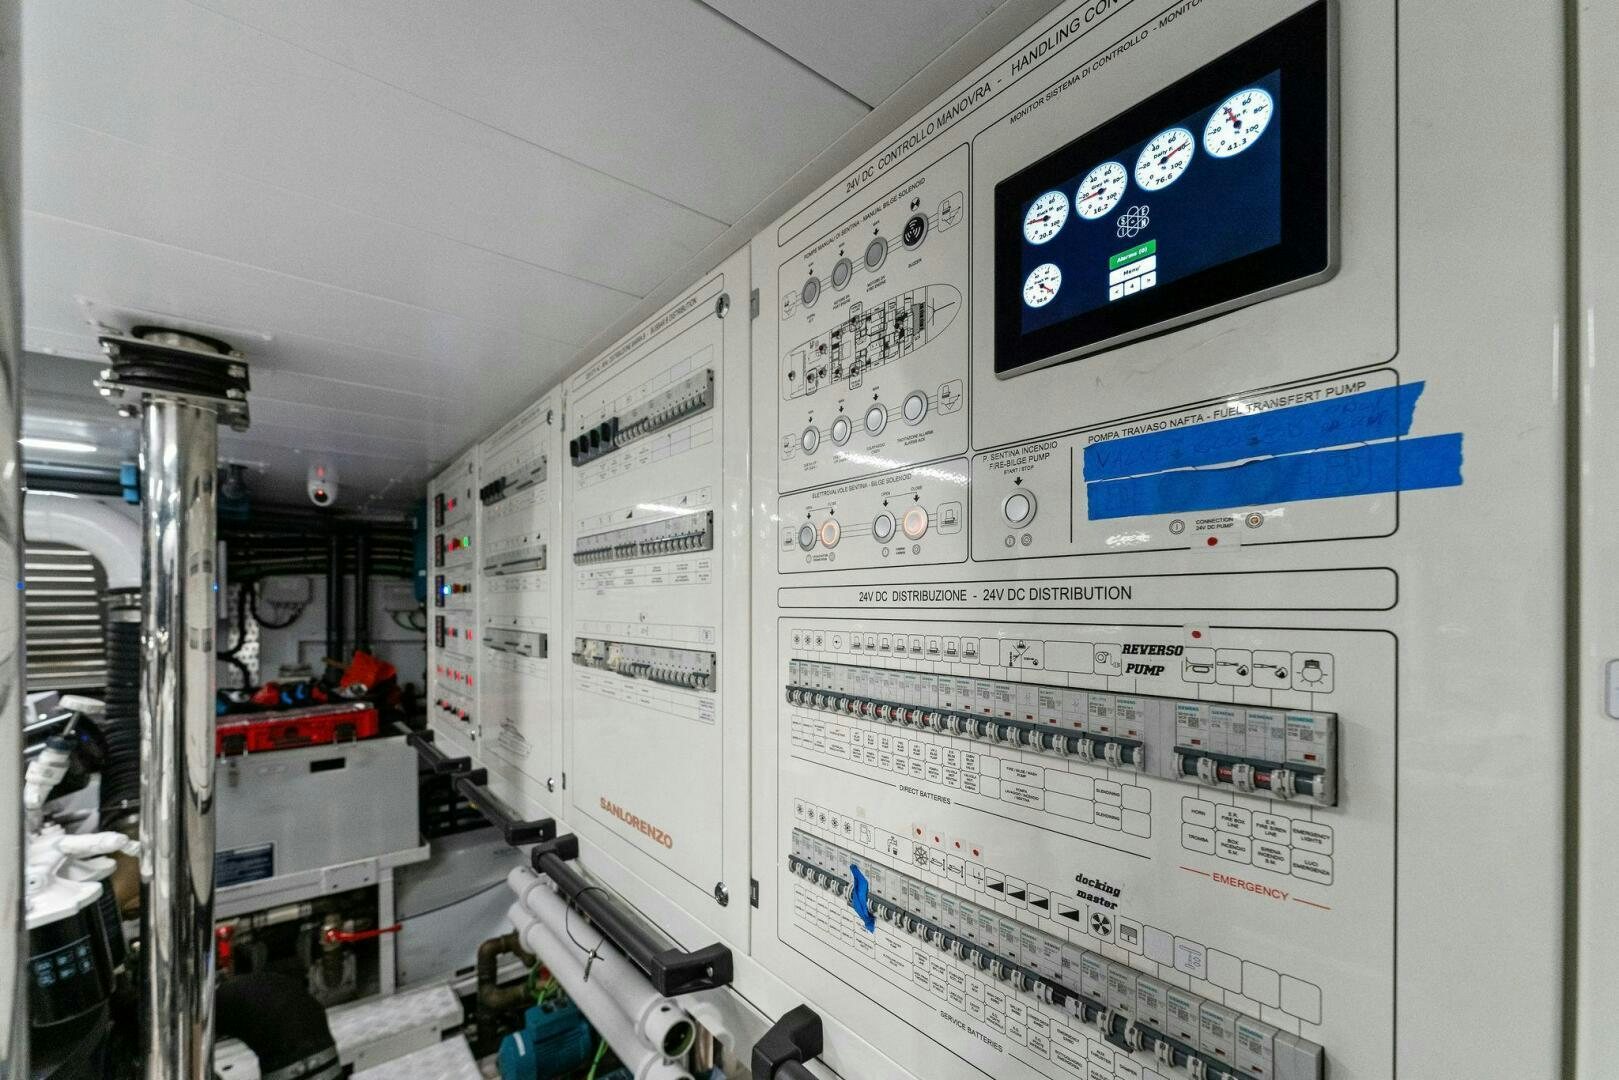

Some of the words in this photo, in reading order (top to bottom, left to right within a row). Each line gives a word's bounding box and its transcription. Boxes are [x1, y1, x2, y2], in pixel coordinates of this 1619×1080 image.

[1010, 97, 1045, 124] MONITOR
[1046, 74, 1080, 102] SISTEMA
[1082, 68, 1091, 80] DI
[1092, 30, 1149, 71] CONTROLLO
[1159, 0, 1202, 29] MONITO
[846, 176, 860, 194] 24V
[862, 166, 874, 182] DC
[878, 122, 934, 174] CONTROLLO
[936, 82, 992, 129] MANOVRA
[1010, 18, 1081, 76] HANDLING
[1246, 124, 1259, 134] 100
[1227, 138, 1247, 151] 41.3
[1153, 150, 1168, 160] Daily
[1170, 160, 1182, 170] 100
[1155, 173, 1173, 185] 76.6
[882, 196, 898, 210] BILGE
[898, 177, 926, 199] SOLENOID
[1106, 192, 1118, 200] 100
[1093, 204, 1108, 214] 16.2
[1088, 430, 1120, 444] POMPA
[1121, 420, 1168, 437] TRAVASO
[1169, 413, 1204, 428] NAFTA
[1213, 406, 1243, 420] FUEL
[1246, 389, 1321, 414] TRANSFERT
[1325, 380, 1366, 398] PUMP
[990, 450, 1020, 461] SENTINA
[1022, 440, 1058, 454] INCENDIO
[989, 458, 1027, 470] FIRE-BILGE
[1028, 452, 1050, 464] PUMP
[886, 473, 912, 485] SOLENOID
[859, 590, 874, 602] 24V
[875, 590, 888, 602] DC
[892, 589, 967, 602] DISTRIBUZIONE
[983, 588, 1004, 602] 24V
[1008, 588, 1026, 601] DC
[1030, 586, 1132, 600] DISTRIBUTION
[1122, 644, 1184, 656] REVERSO
[1126, 663, 1165, 676] PUMP
[899, 784, 920, 796] DIRECT
[920, 790, 951, 804] BATTERIES
[600, 797, 673, 849] SANLORENZO
[1292, 828, 1331, 840] EMERGENCY
[1075, 873, 1121, 898] docking
[1212, 872, 1289, 901] EMERGENCY
[1076, 889, 1118, 910] master
[940, 1011, 966, 1031] SERVICE
[967, 1026, 1003, 1053] BATTERIES
